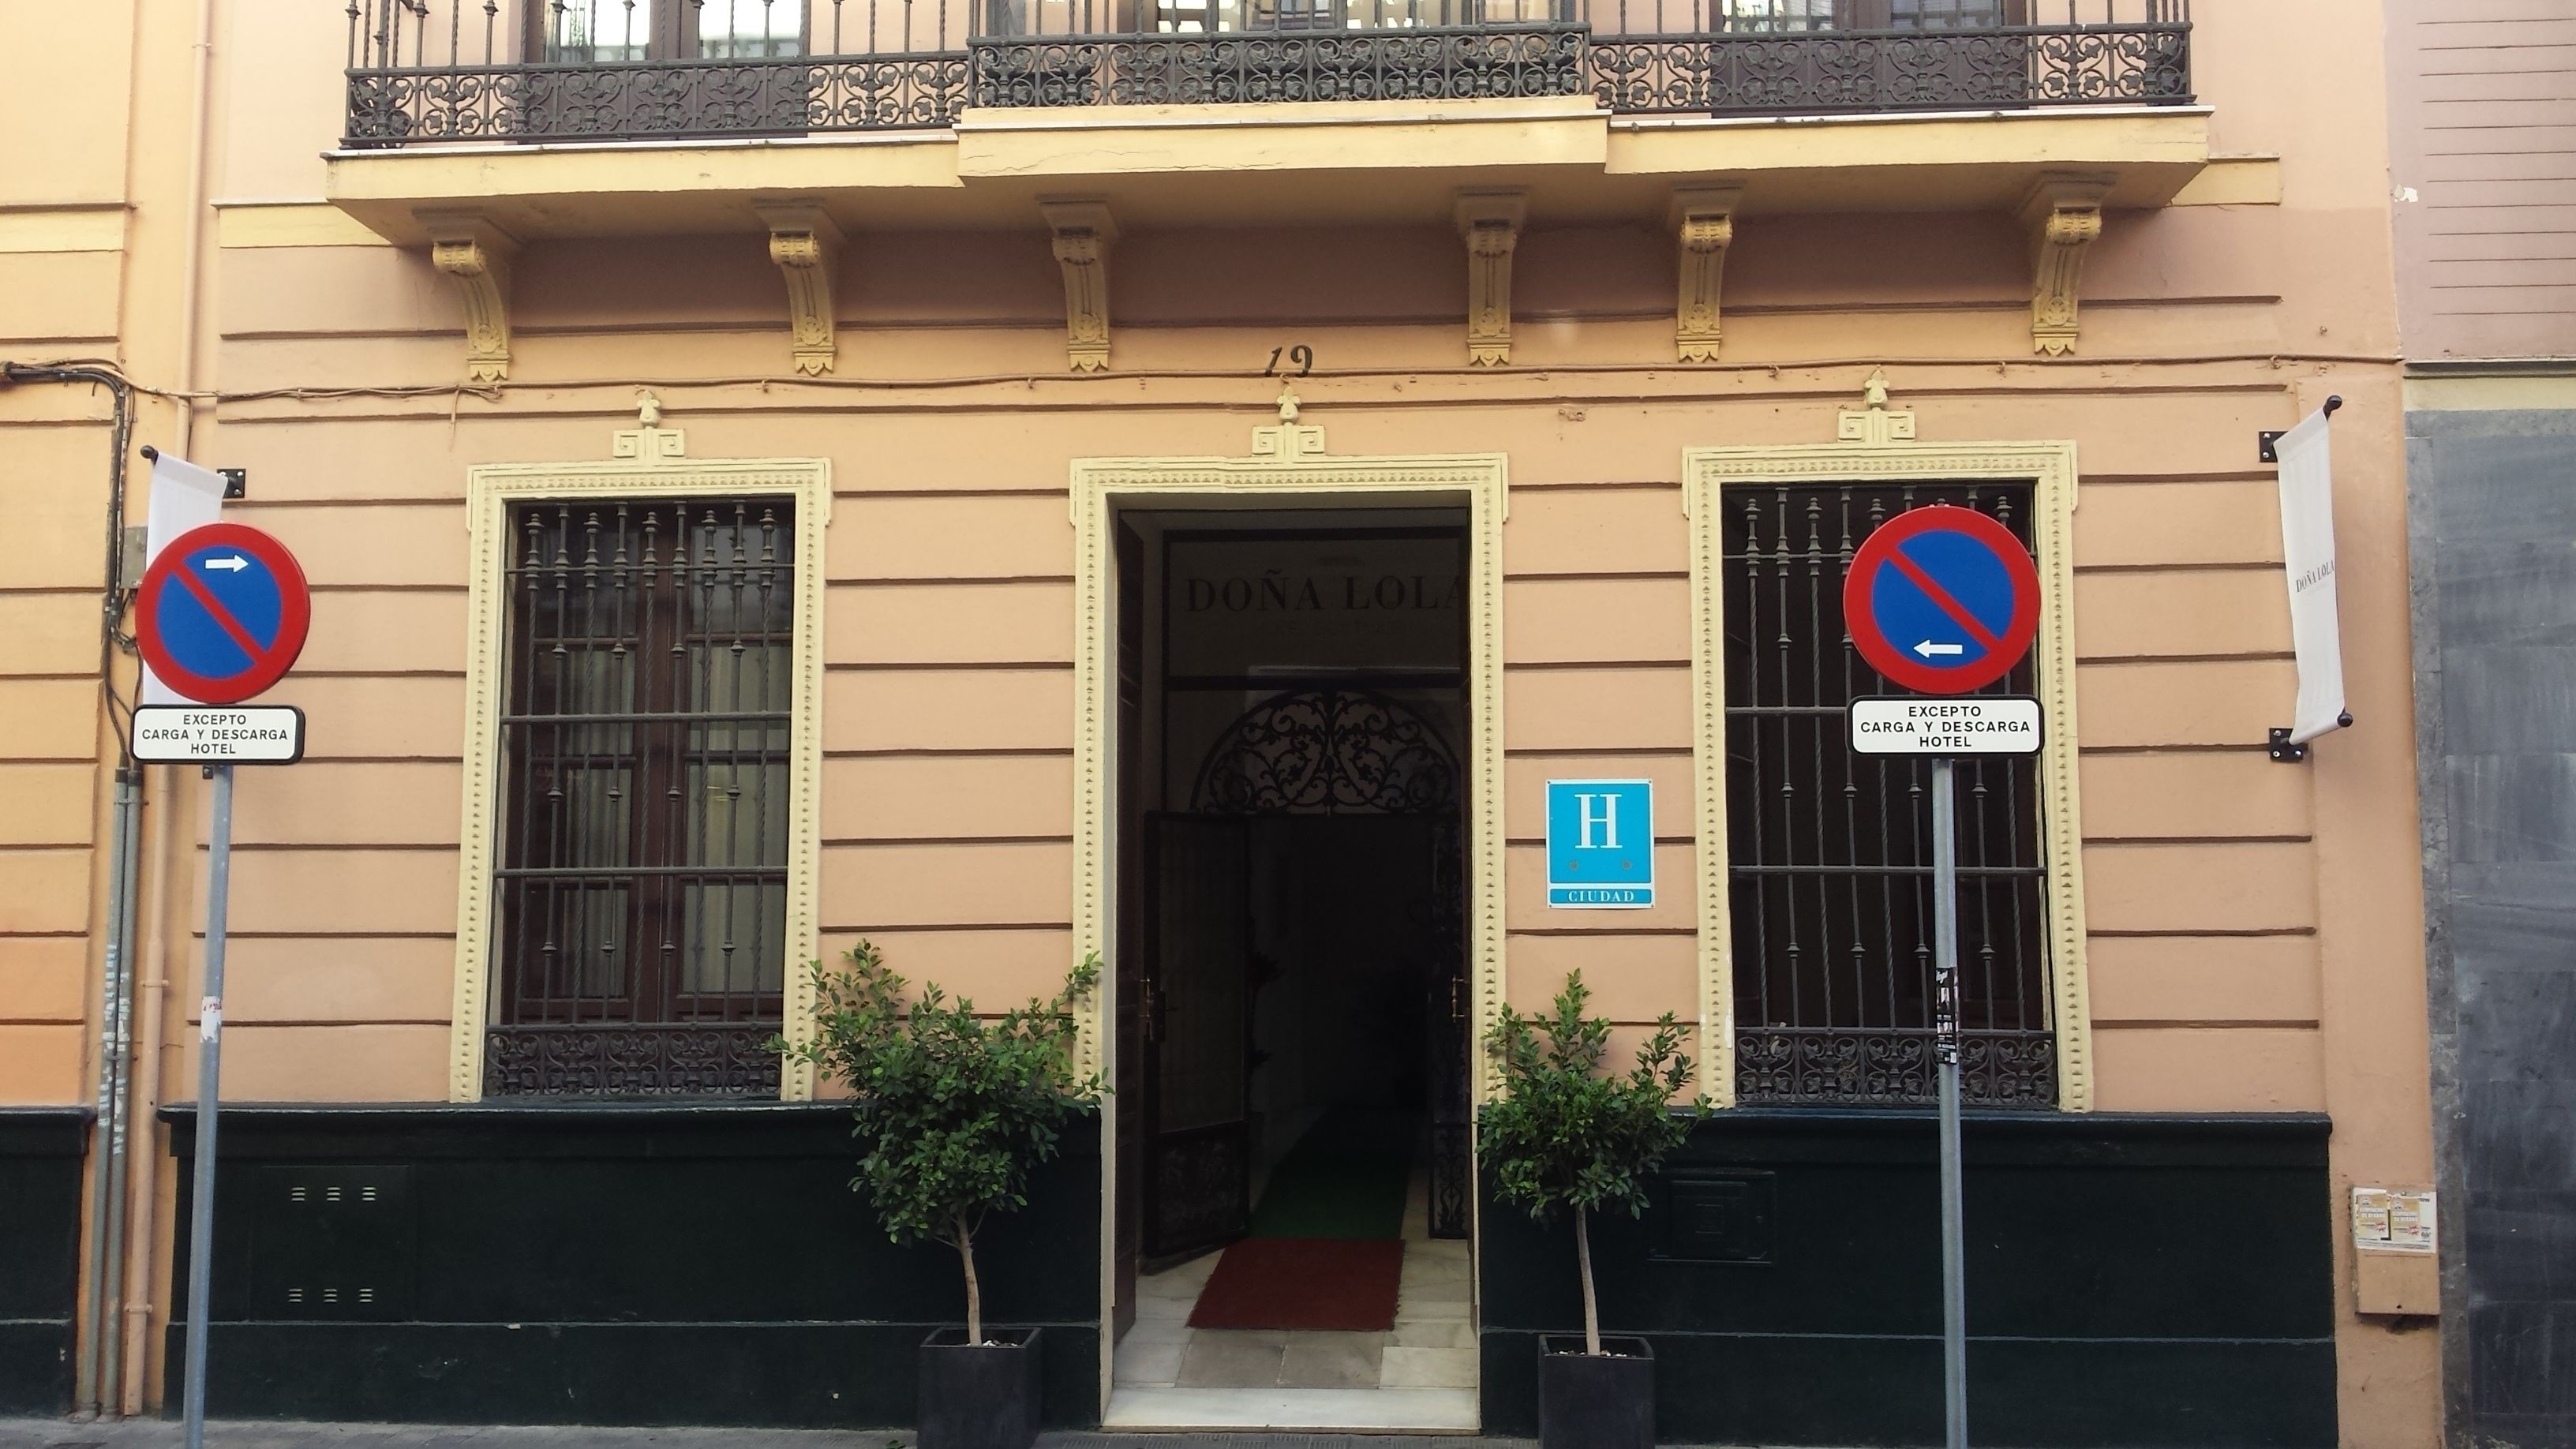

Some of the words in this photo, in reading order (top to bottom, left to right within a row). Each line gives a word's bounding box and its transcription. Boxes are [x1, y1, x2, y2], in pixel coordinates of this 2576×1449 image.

[1264, 345, 1312, 377] 19
[1186, 569, 1325, 612] DOÑA
[1908, 706, 1982, 717] EXCEPTO
[183, 714, 246, 725] EXCEPTO
[1860, 721, 1915, 732] CARGA
[1924, 721, 1933, 732] Y
[1942, 721, 2031, 732] DESCARGA
[142, 729, 189, 739] CARGA
[197, 729, 204, 739] Y
[212, 729, 288, 740] DESCARGA
[1919, 736, 1972, 747] HOTEL
[191, 743, 236, 754] HOTEL
[1574, 793, 1623, 848] H
[1568, 890, 1634, 902] CIUDAD
